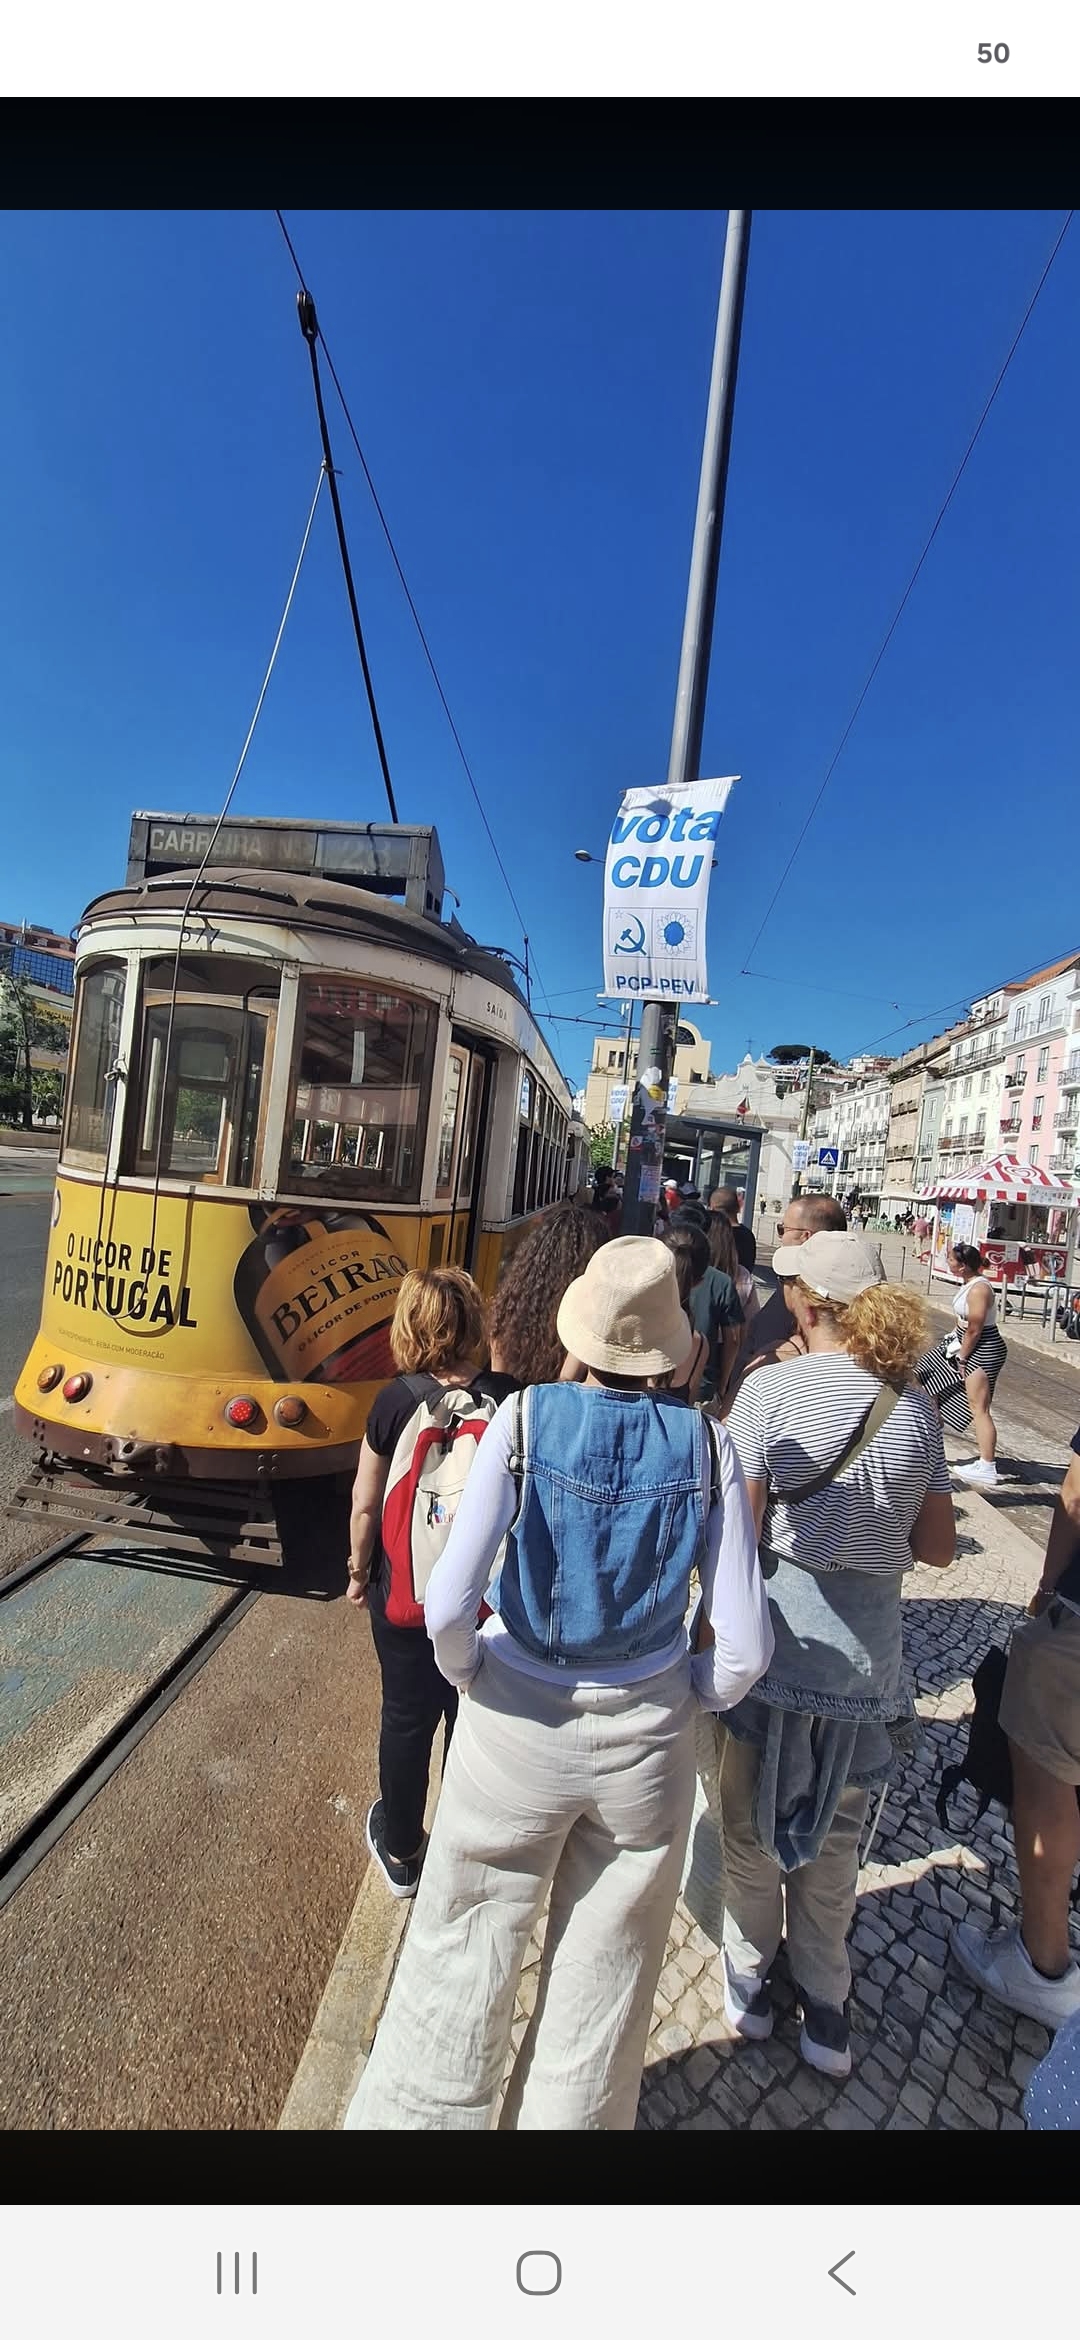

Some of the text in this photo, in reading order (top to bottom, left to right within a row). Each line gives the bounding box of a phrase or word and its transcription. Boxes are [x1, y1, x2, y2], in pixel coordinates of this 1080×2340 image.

[611, 806, 724, 844] vota
[611, 854, 704, 889] CDU
[616, 975, 696, 995] PCP-PEV
[67, 1233, 172, 1277] O LICOR DE
[310, 1250, 361, 1276] LICOR
[52, 1260, 197, 1328] PORTUGAL
[270, 1252, 409, 1345] BEIRÃO
[306, 1313, 343, 1345] LICOR
[343, 1302, 363, 1318] DE
[363, 1286, 401, 1306] PORTU
